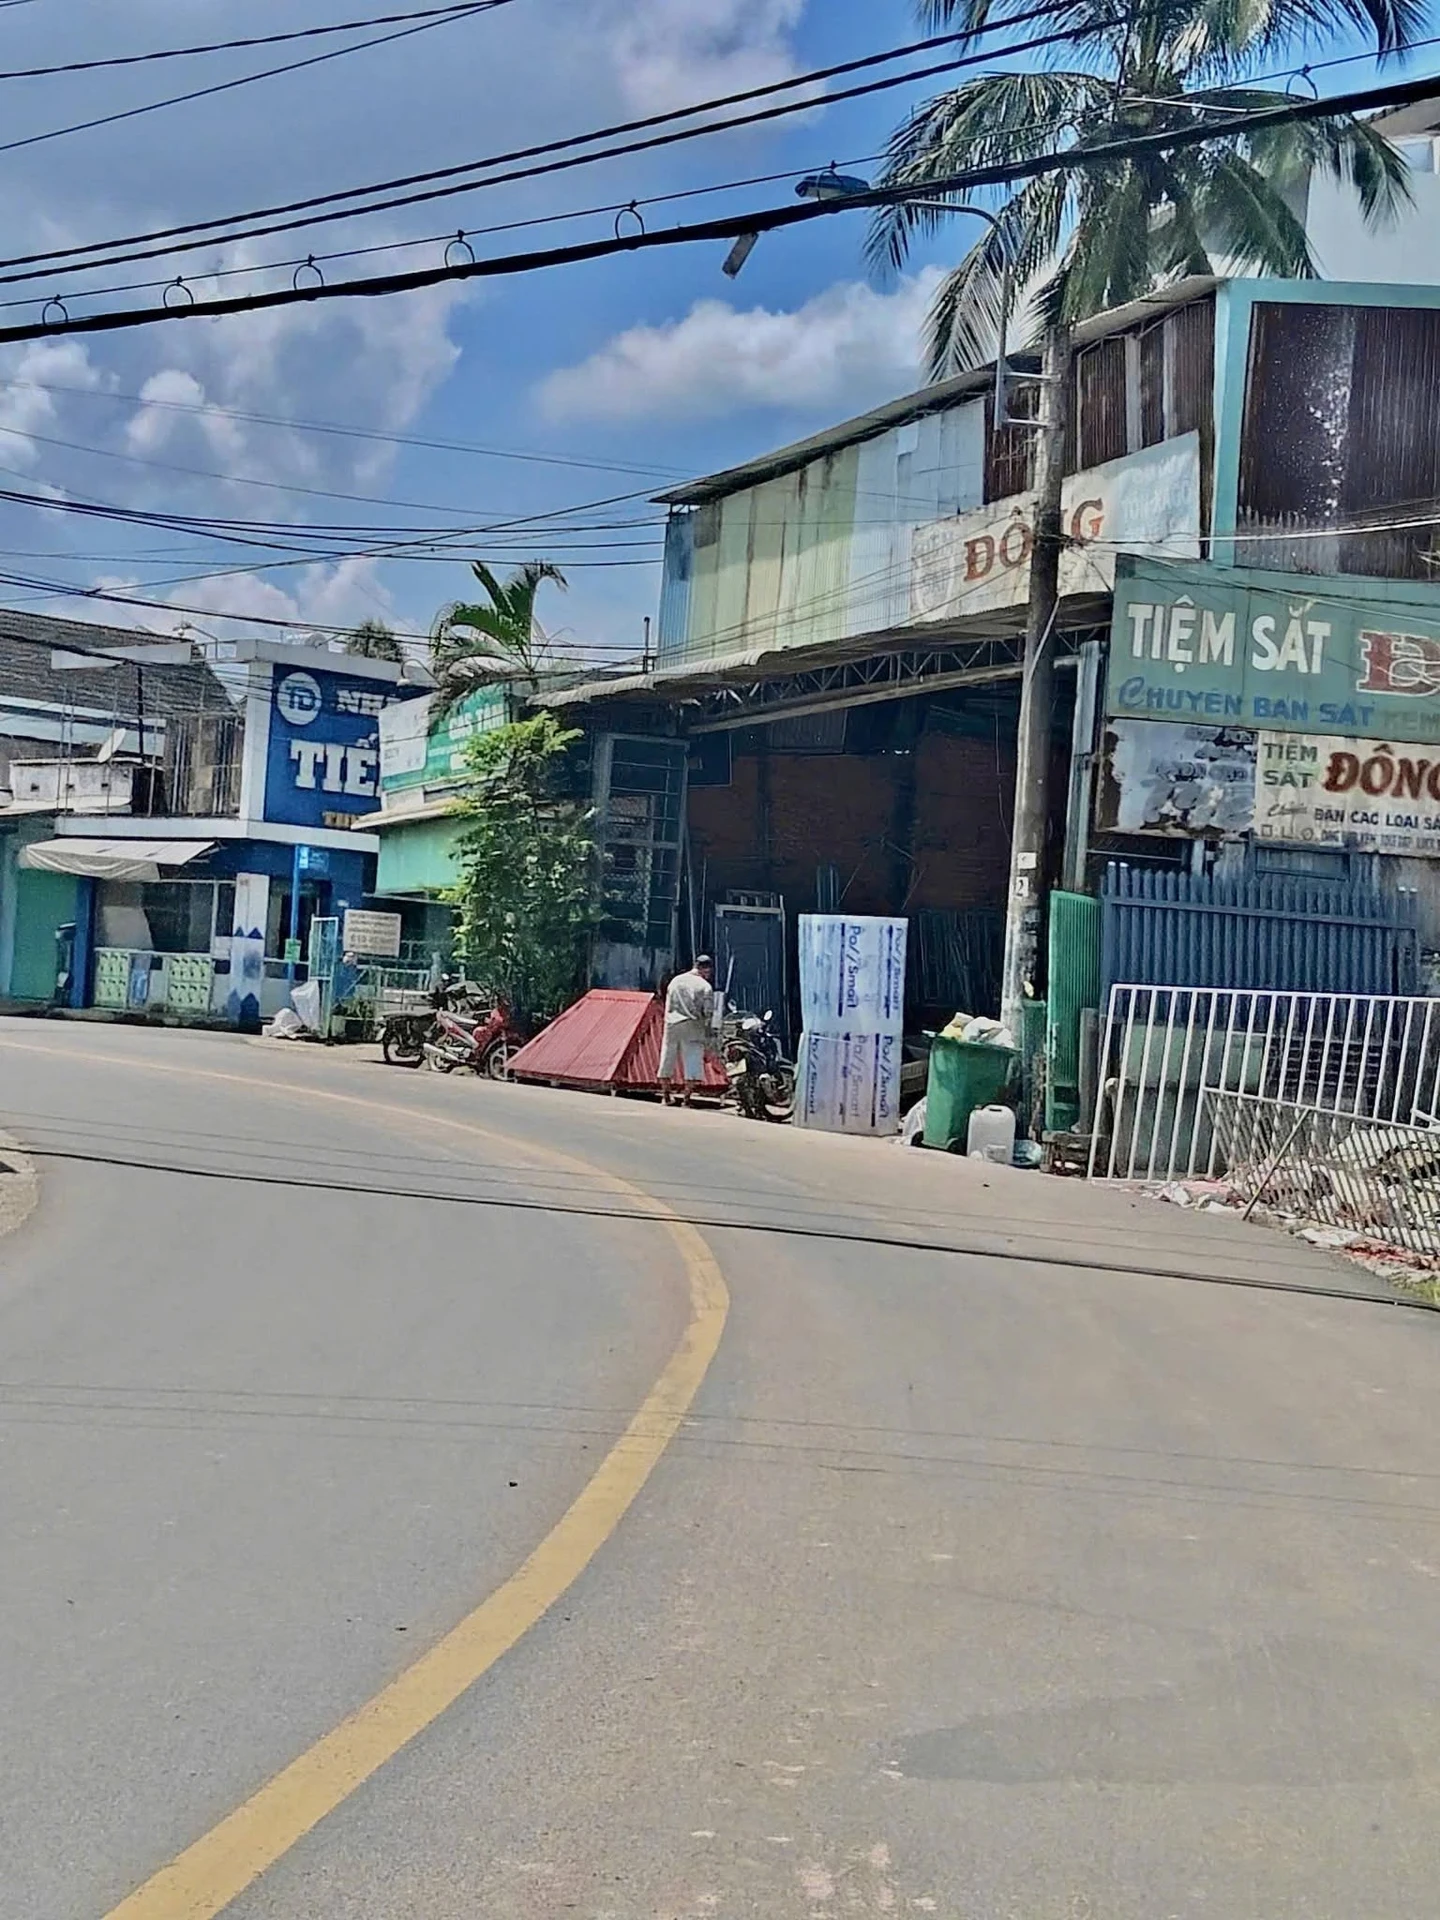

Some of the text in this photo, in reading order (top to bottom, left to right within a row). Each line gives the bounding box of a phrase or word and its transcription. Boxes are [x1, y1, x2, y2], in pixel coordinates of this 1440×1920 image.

[963, 498, 1105, 582] ĐÔG
[1128, 595, 1236, 673] TIỆM
[1251, 600, 1331, 674] SẮT
